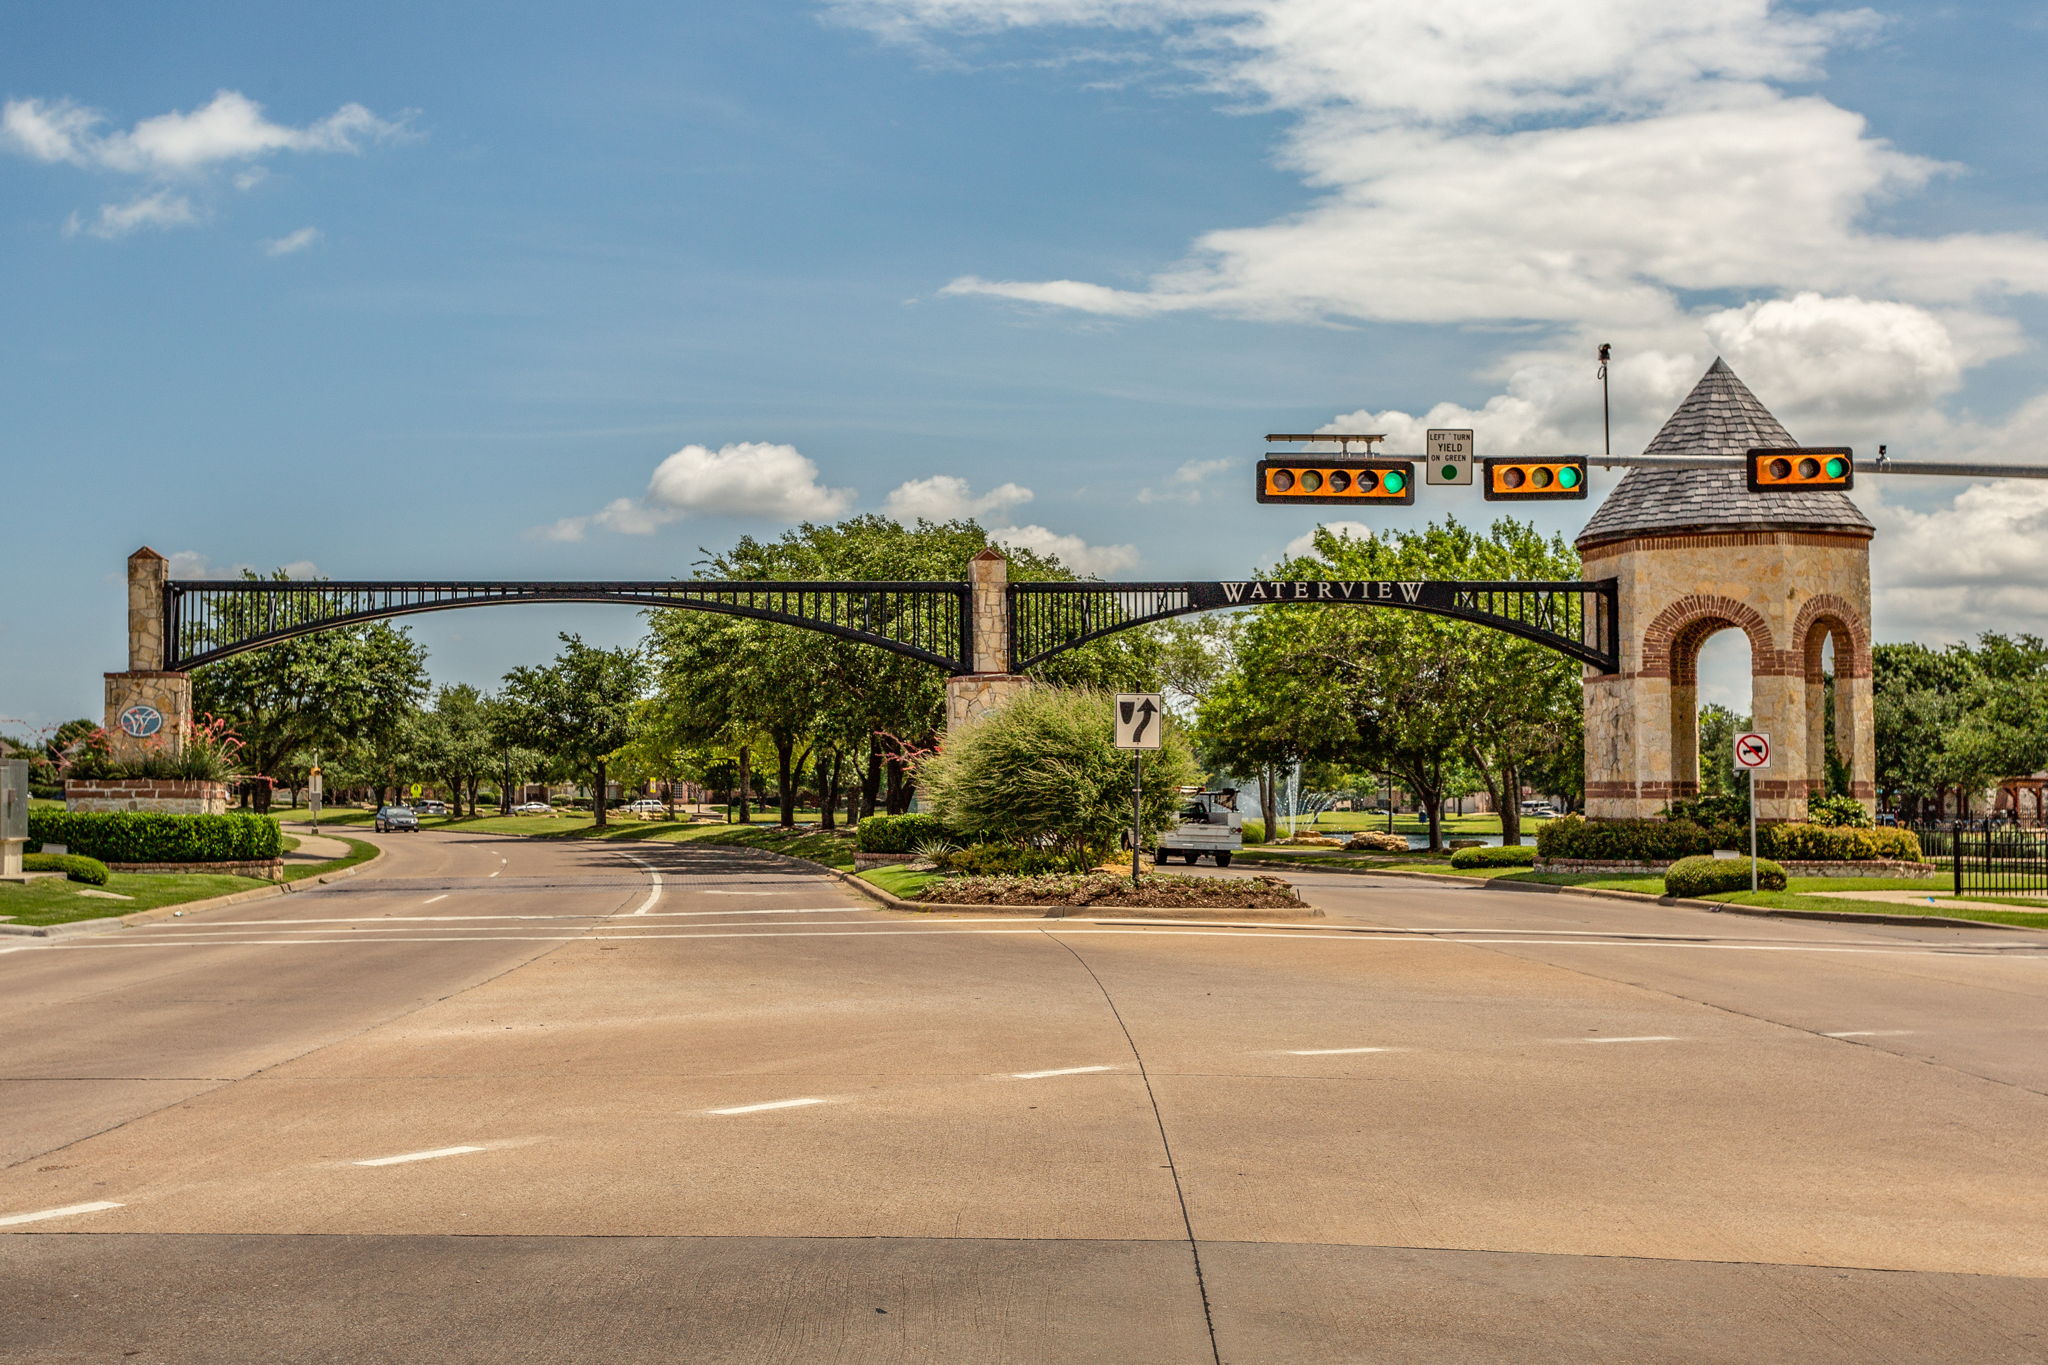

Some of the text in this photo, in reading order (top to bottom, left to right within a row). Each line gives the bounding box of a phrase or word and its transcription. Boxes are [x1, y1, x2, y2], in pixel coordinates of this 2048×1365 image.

[1430, 433, 1471, 441] LEFT TURN
[1438, 443, 1463, 452] YIELD
[1431, 454, 1466, 462] ON GREEN
[1220, 582, 1424, 603] WATERVIEW
